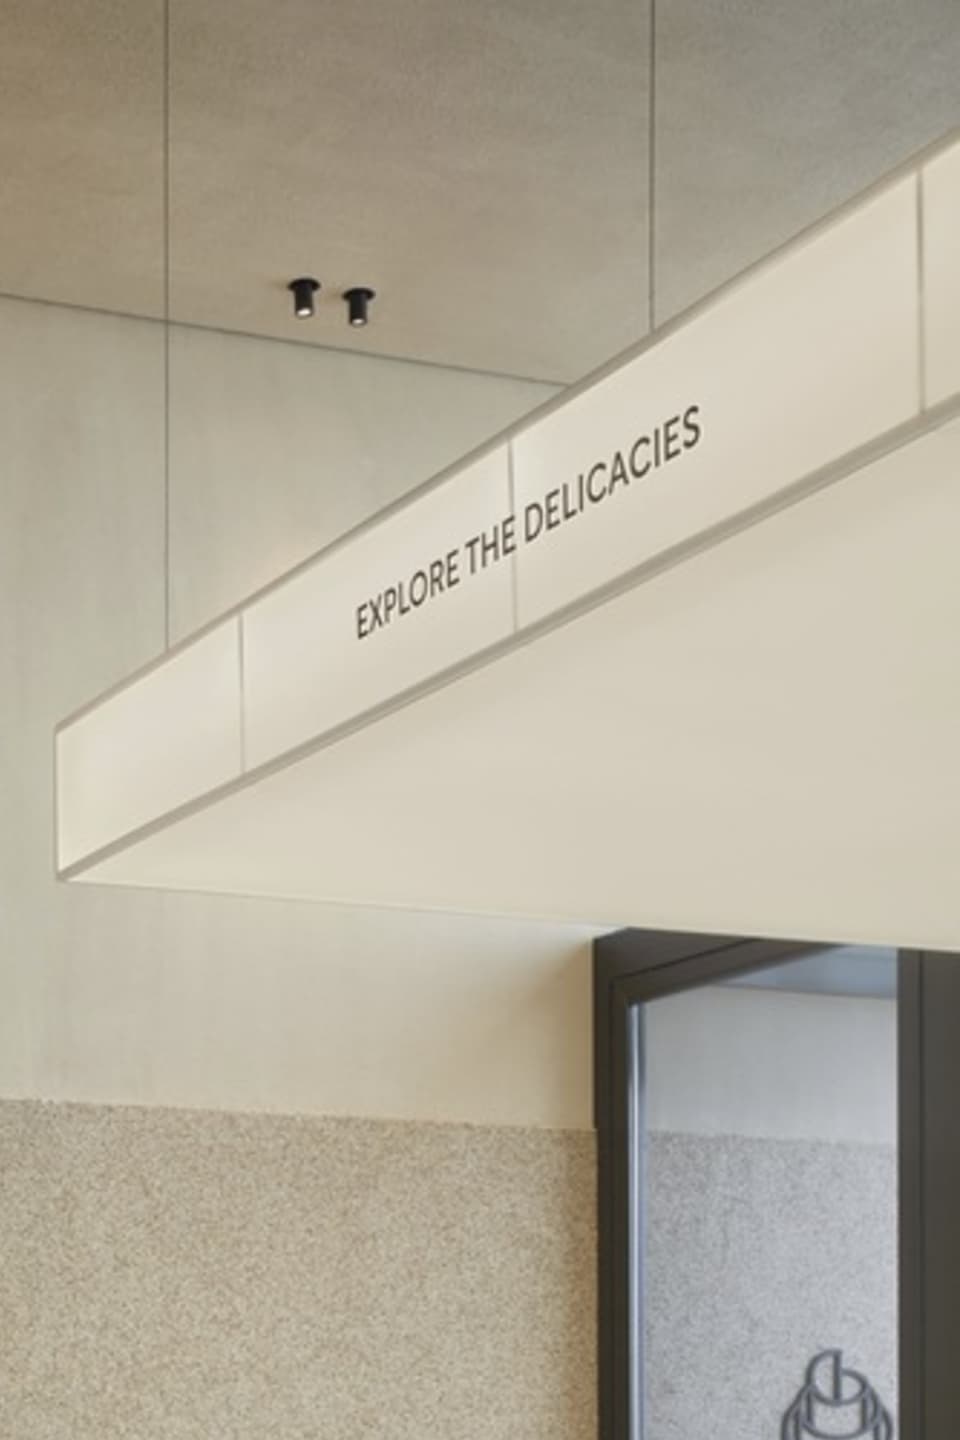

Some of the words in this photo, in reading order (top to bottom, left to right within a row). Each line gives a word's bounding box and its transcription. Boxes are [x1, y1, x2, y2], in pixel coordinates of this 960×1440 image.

[357, 549, 461, 639] EXPLORE
[465, 515, 516, 574] THE
[525, 405, 701, 542] DELICACIES
